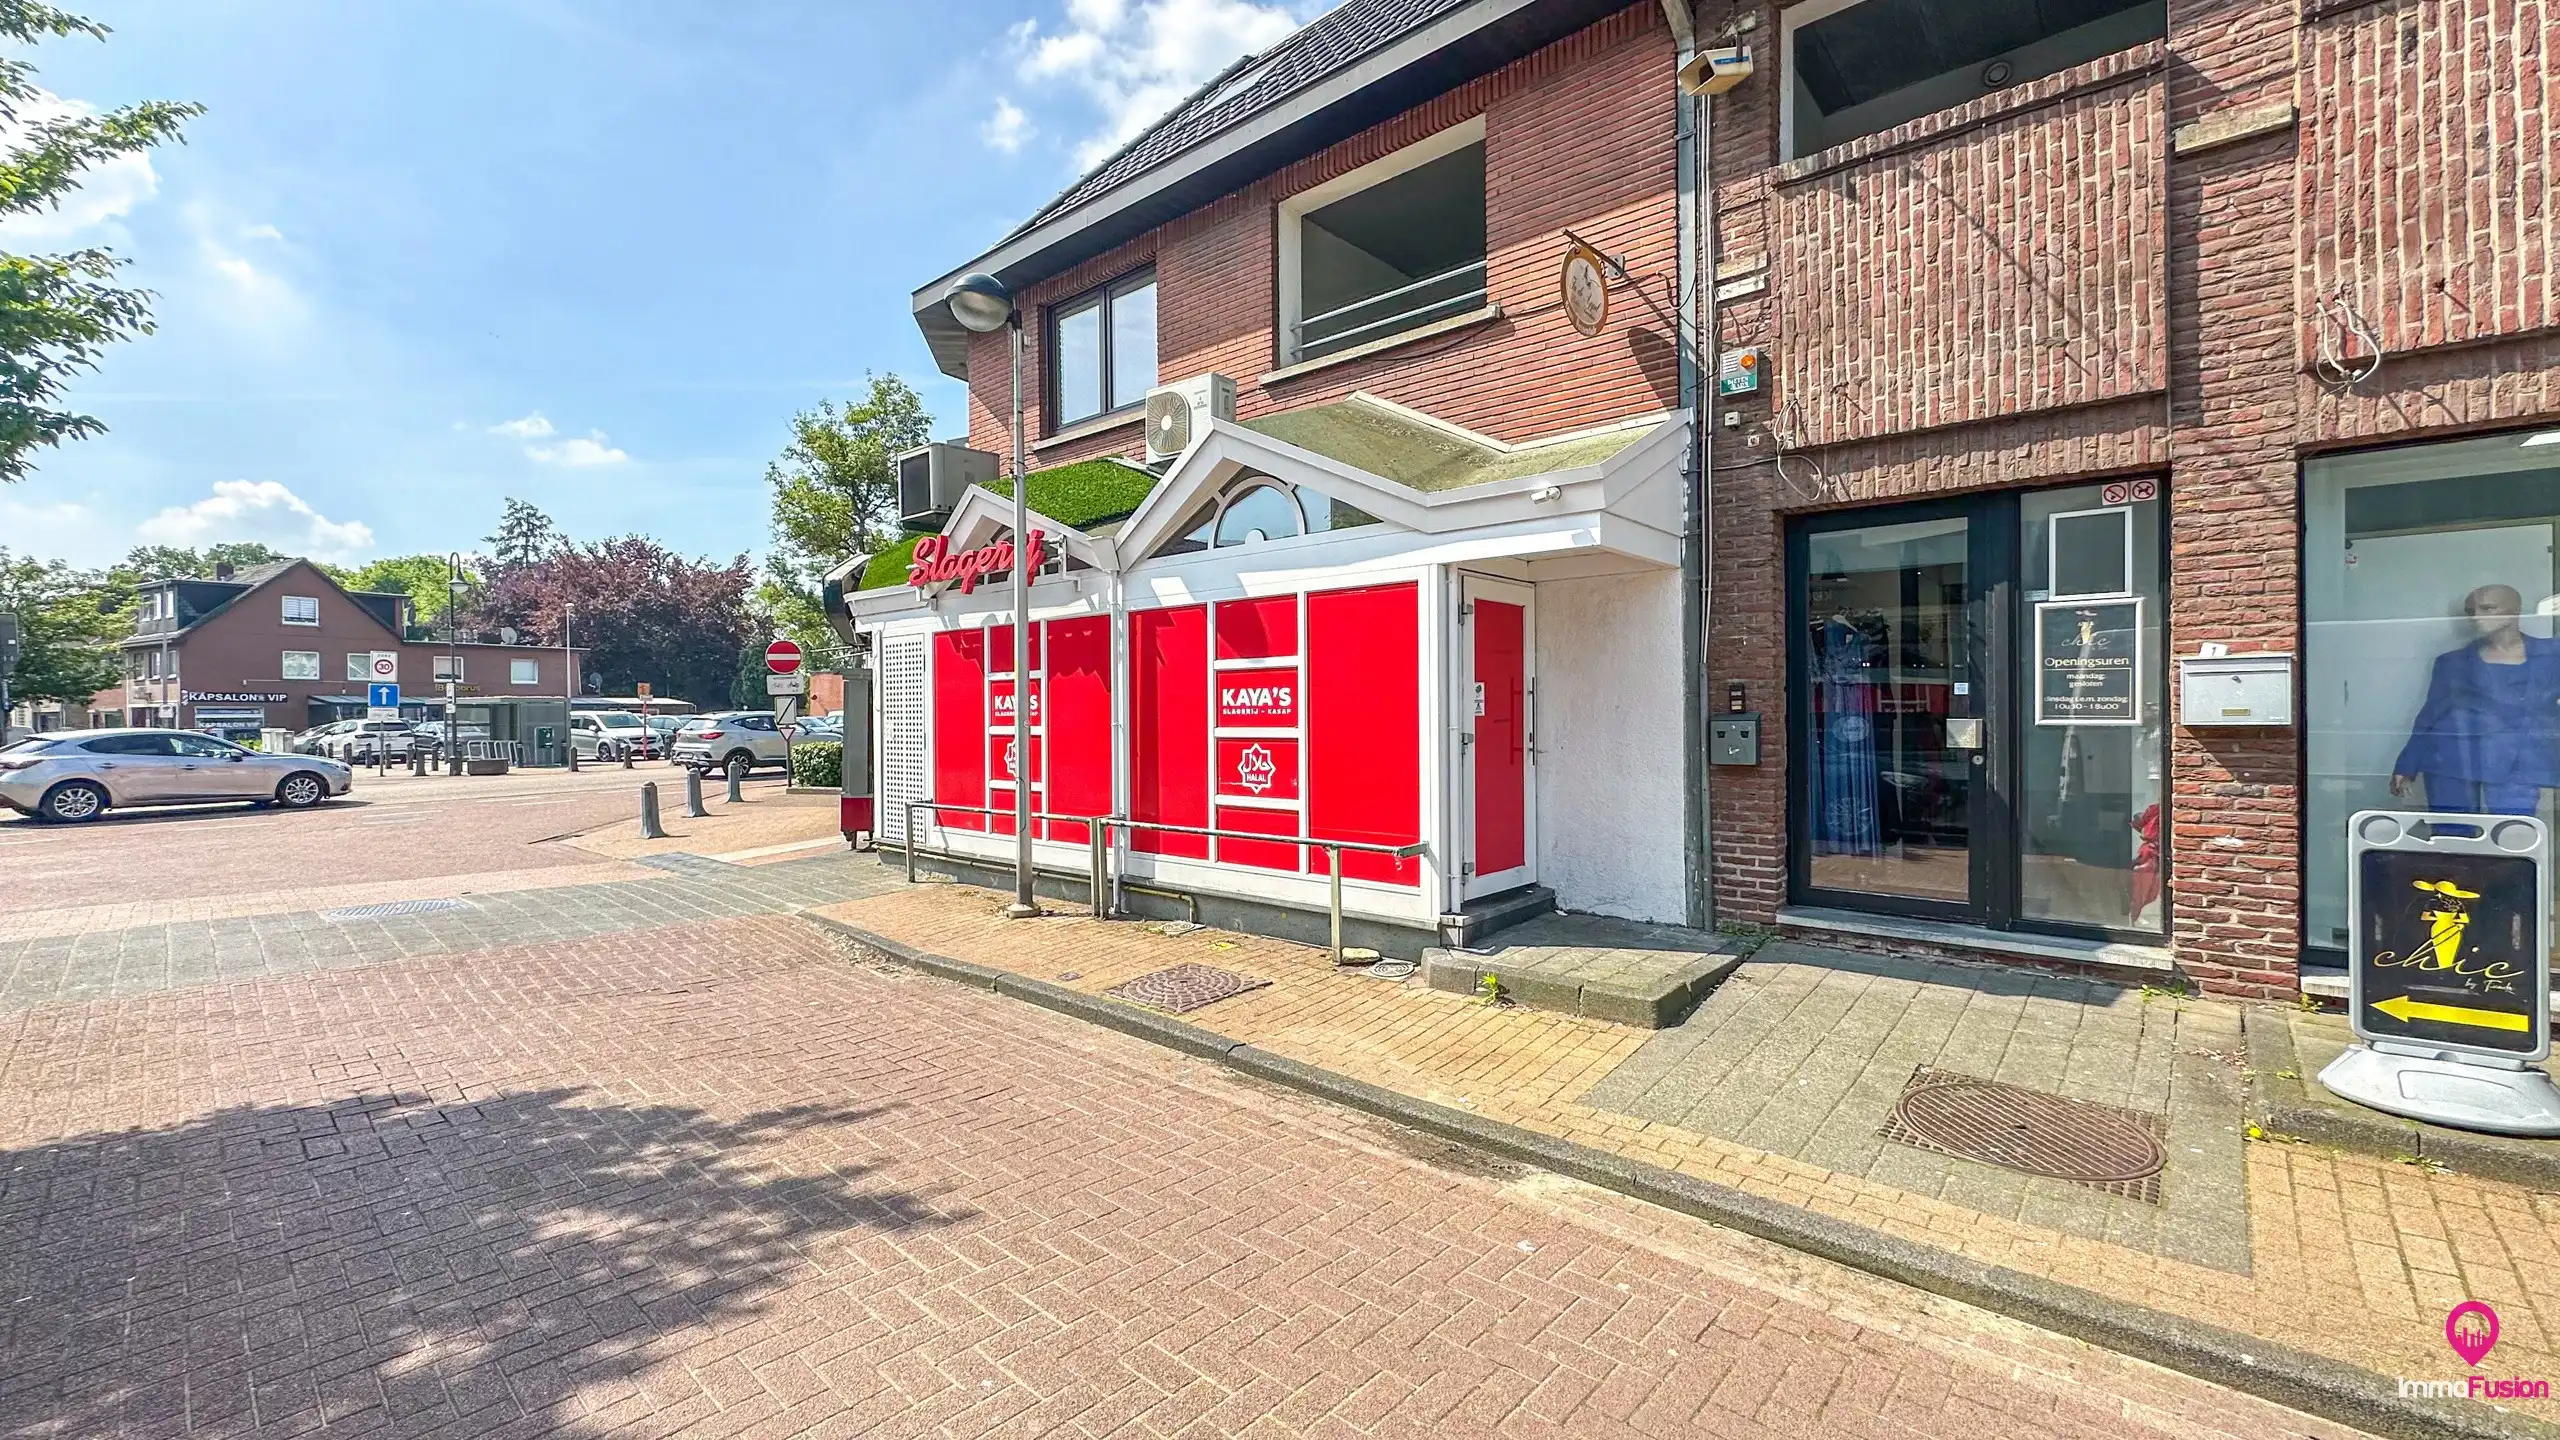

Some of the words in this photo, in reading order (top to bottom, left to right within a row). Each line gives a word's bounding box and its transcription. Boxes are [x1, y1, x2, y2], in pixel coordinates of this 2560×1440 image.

[909, 529, 1047, 594] Slagerj
[2211, 646, 2217, 656] 1
[2045, 657, 2129, 668] Openingsuren
[189, 692, 257, 701] KAPSALON
[267, 694, 287, 702] VIP
[1222, 687, 1292, 706] KAYA'S
[1246, 774, 1267, 782] HALAL
[2374, 930, 2525, 978] chic
